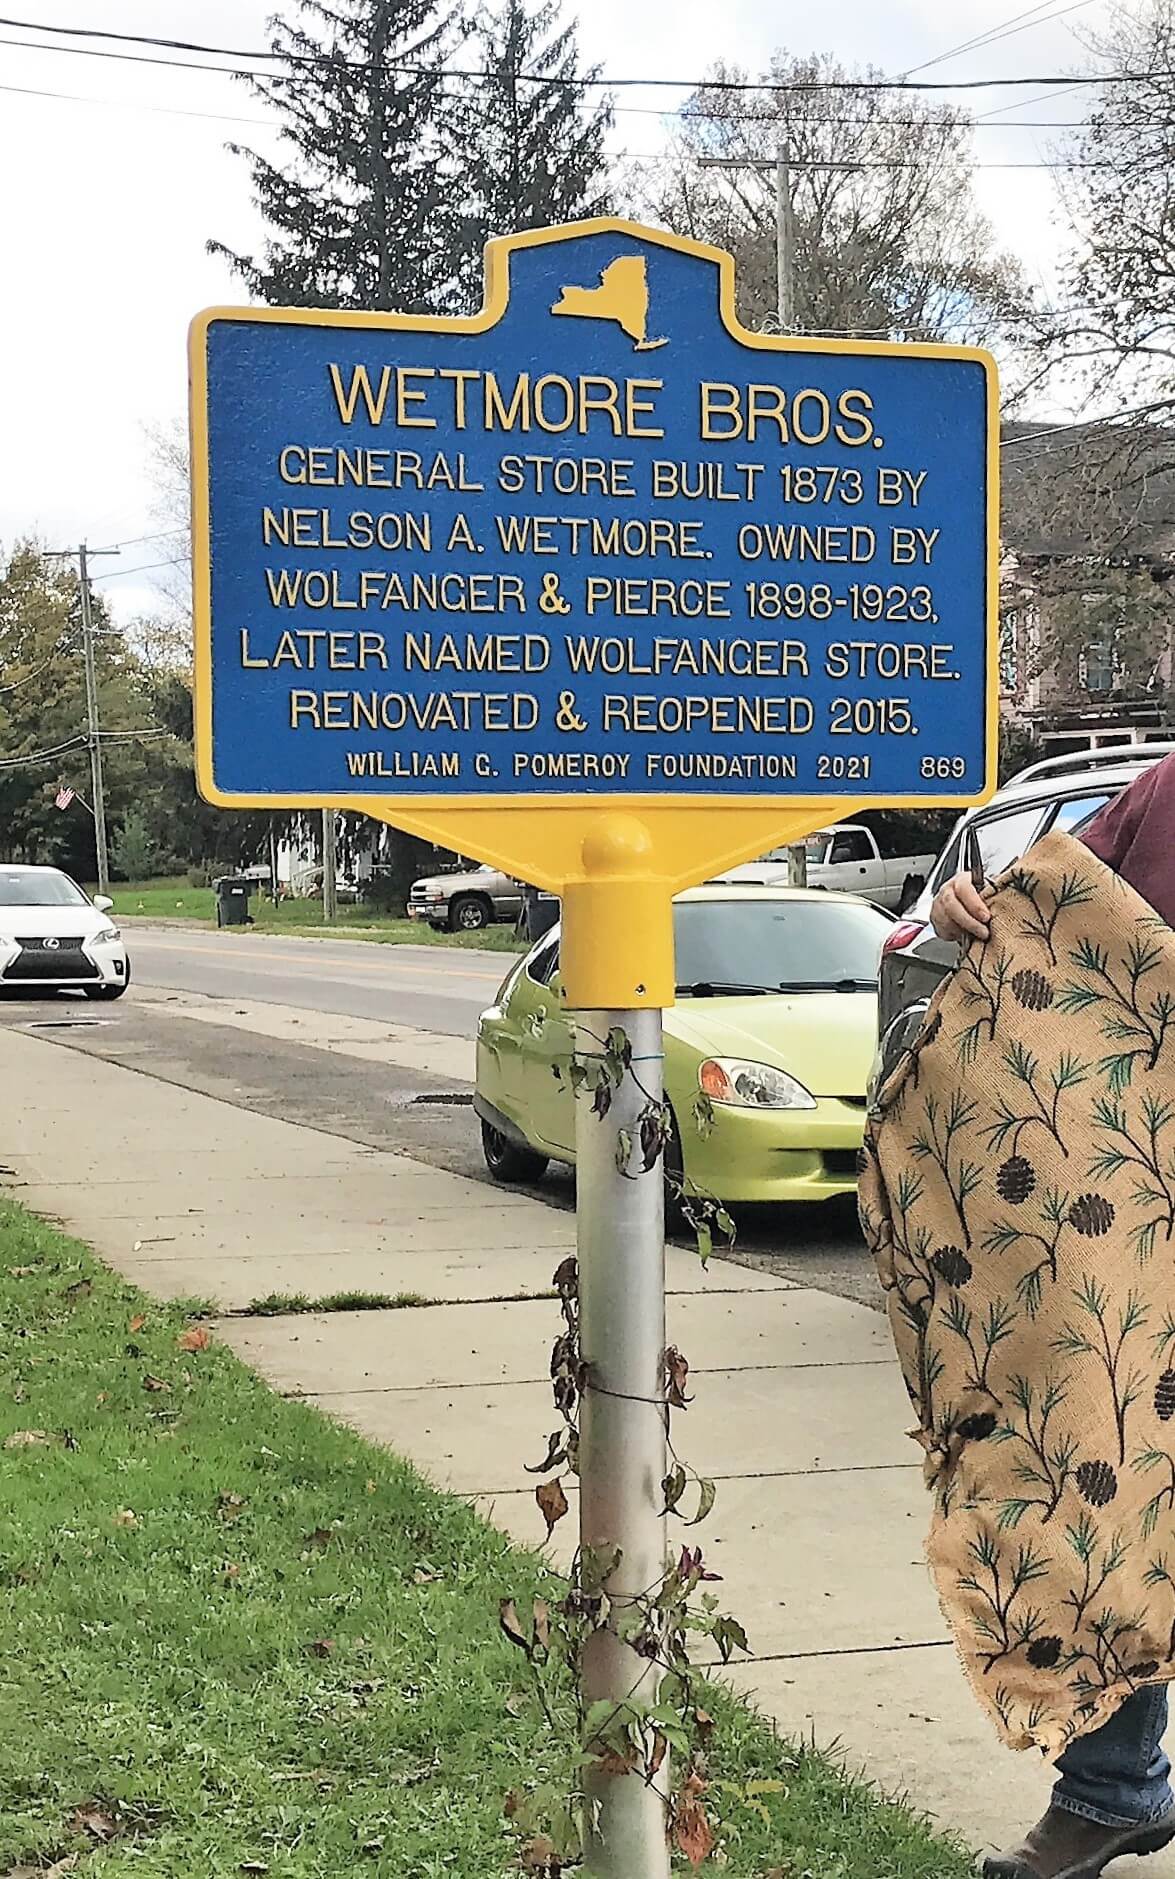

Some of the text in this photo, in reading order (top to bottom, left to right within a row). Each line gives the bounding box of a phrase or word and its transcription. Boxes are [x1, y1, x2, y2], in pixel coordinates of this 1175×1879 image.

[330, 363, 883, 448] WETMORE BROS.
[280, 446, 928, 506] GENERAL STORE BUILT 1873 BY
[263, 507, 940, 564] NELSON A. WETMORE. OWNED BY
[266, 568, 939, 624] WOLFANGER & PIERCE 1898-1923,
[241, 629, 961, 679] LATER NAMED WOLFANGER STORE.
[291, 690, 919, 735] RENOVATED & REOPENED 2015.
[347, 752, 870, 778] WILLIAM G. POMEROY FOUNDATION 2021
[921, 756, 965, 778] 869
